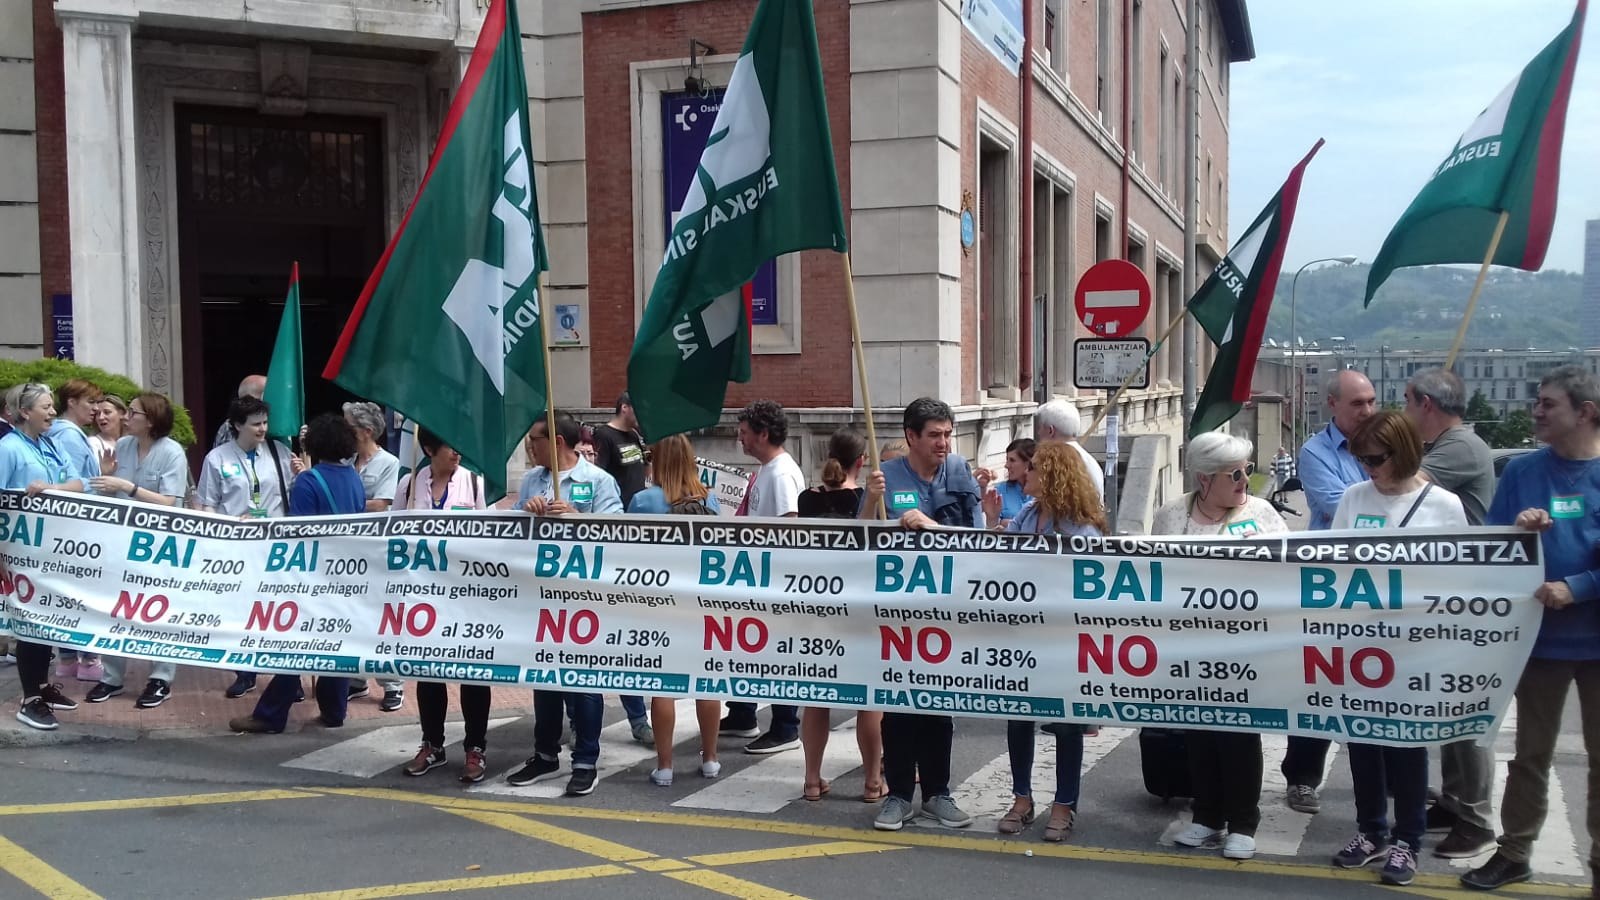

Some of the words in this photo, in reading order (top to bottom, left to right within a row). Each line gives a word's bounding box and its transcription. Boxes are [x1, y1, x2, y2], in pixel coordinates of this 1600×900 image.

[1215, 260, 1244, 299] EUSK
[672, 313, 699, 361] UA
[1, 494, 19, 509] PE
[21, 496, 120, 523] OSAKIDETZA
[135, 512, 168, 530] OPE
[171, 517, 264, 539] OSAKIDETZA
[274, 523, 296, 538] OPE
[299, 521, 380, 536] OSAKIDETZA
[391, 520, 421, 535] OPE
[422, 519, 524, 537] OSAKIDETZA
[539, 523, 573, 540] OPE
[577, 523, 685, 543] OSAKIDETZA
[700, 527, 736, 544] OPE
[740, 528, 858, 548] OSAKIDETZA
[52, 538, 102, 559] 7.000
[126, 530, 196, 569] BAI
[200, 559, 244, 575] 7.000
[876, 532, 916, 549] OPE
[919, 532, 1050, 551] OSAKIDETZA
[1070, 535, 1116, 553] OPE
[1120, 538, 1273, 560] OSAKIDETZA
[1296, 544, 1349, 561] OPE
[1354, 540, 1529, 562] OSAKIDETZA
[41, 560, 102, 579] gehiagori
[265, 541, 319, 572] BAI
[325, 559, 368, 576] 7.000
[387, 539, 448, 573] BAI
[459, 560, 510, 578] 7.000
[534, 543, 604, 580] BAI
[613, 568, 670, 587] 7.000
[122, 570, 182, 590] lanpostu
[183, 578, 242, 594] gehiagori
[698, 549, 771, 587] BAI
[783, 574, 844, 595] 7.000
[875, 554, 954, 594] BAI
[967, 579, 1037, 602] 7.000
[257, 581, 310, 596] lanpostu
[311, 582, 369, 597] gehiagori
[385, 580, 445, 596] lanpostu
[449, 583, 518, 600] gehiagori
[539, 586, 603, 603] lanpostu
[606, 589, 676, 608] gehiagori
[1072, 559, 1163, 602] BAI
[1180, 587, 1259, 611] 7.000
[1300, 566, 1402, 610] BAI
[1423, 595, 1512, 617] 7.000
[40, 593, 51, 607] al
[111, 590, 169, 622] NO
[168, 613, 185, 624] al
[185, 614, 221, 627] 38%
[698, 596, 767, 614] lanpostu
[771, 599, 849, 619] gehiagori
[245, 600, 298, 632] NO
[300, 618, 315, 633] al
[316, 618, 352, 633] 38%
[378, 602, 437, 637] NO
[441, 622, 457, 638] al
[463, 623, 504, 640] 38%
[874, 604, 951, 621] lanpostu
[957, 609, 1045, 625] gehiagori
[1074, 612, 1163, 628] lanpostu
[1168, 617, 1268, 634] gehiagori
[109, 623, 126, 634] de
[127, 626, 210, 645] temporalidad
[535, 609, 599, 645] NO
[605, 629, 622, 646] al
[626, 630, 670, 648] 38%
[703, 615, 768, 653] NO
[776, 636, 794, 654] al
[798, 638, 845, 657] 38%
[1302, 618, 1401, 640] lanpostu
[1407, 624, 1520, 646] gehiagori
[95, 638, 121, 650] ELA
[124, 641, 202, 661] Osakidetza
[239, 635, 256, 648] de
[257, 637, 343, 652] temporalidad
[375, 641, 393, 655] de
[395, 643, 495, 661] temporalidad
[879, 625, 952, 664] NO
[961, 647, 978, 665] al
[985, 648, 1037, 669] 38%
[226, 652, 254, 665] ELA
[257, 653, 337, 672] Osakidetza
[535, 650, 554, 663] de
[558, 651, 662, 670] temporalidad
[704, 658, 724, 673] de
[728, 659, 837, 680] temporalidad
[1077, 633, 1158, 677] NO
[1169, 660, 1190, 678] al
[1197, 660, 1258, 681] 38%
[1303, 645, 1395, 688] NO
[1408, 672, 1430, 691] al
[1440, 672, 1502, 693] 38%
[365, 660, 395, 674] ELA
[399, 661, 492, 681] Osakidetza
[525, 669, 557, 684] ELA
[564, 670, 663, 691] Osakidetza
[882, 668, 902, 683] de
[908, 669, 1029, 692] temporalidad
[695, 677, 728, 693] ELA
[735, 678, 838, 701] Osakidetza
[874, 688, 910, 706] ELA
[917, 692, 1032, 714] Osakidetza
[1079, 681, 1104, 697] de
[1110, 683, 1249, 704] temporalidad
[1072, 702, 1114, 718] ELA
[1121, 704, 1252, 725] Osakidetza
[1306, 691, 1333, 708] de
[1340, 693, 1490, 717] temporalidad
[1297, 712, 1342, 733] ELA
[1351, 717, 1491, 741] Osakidetza
